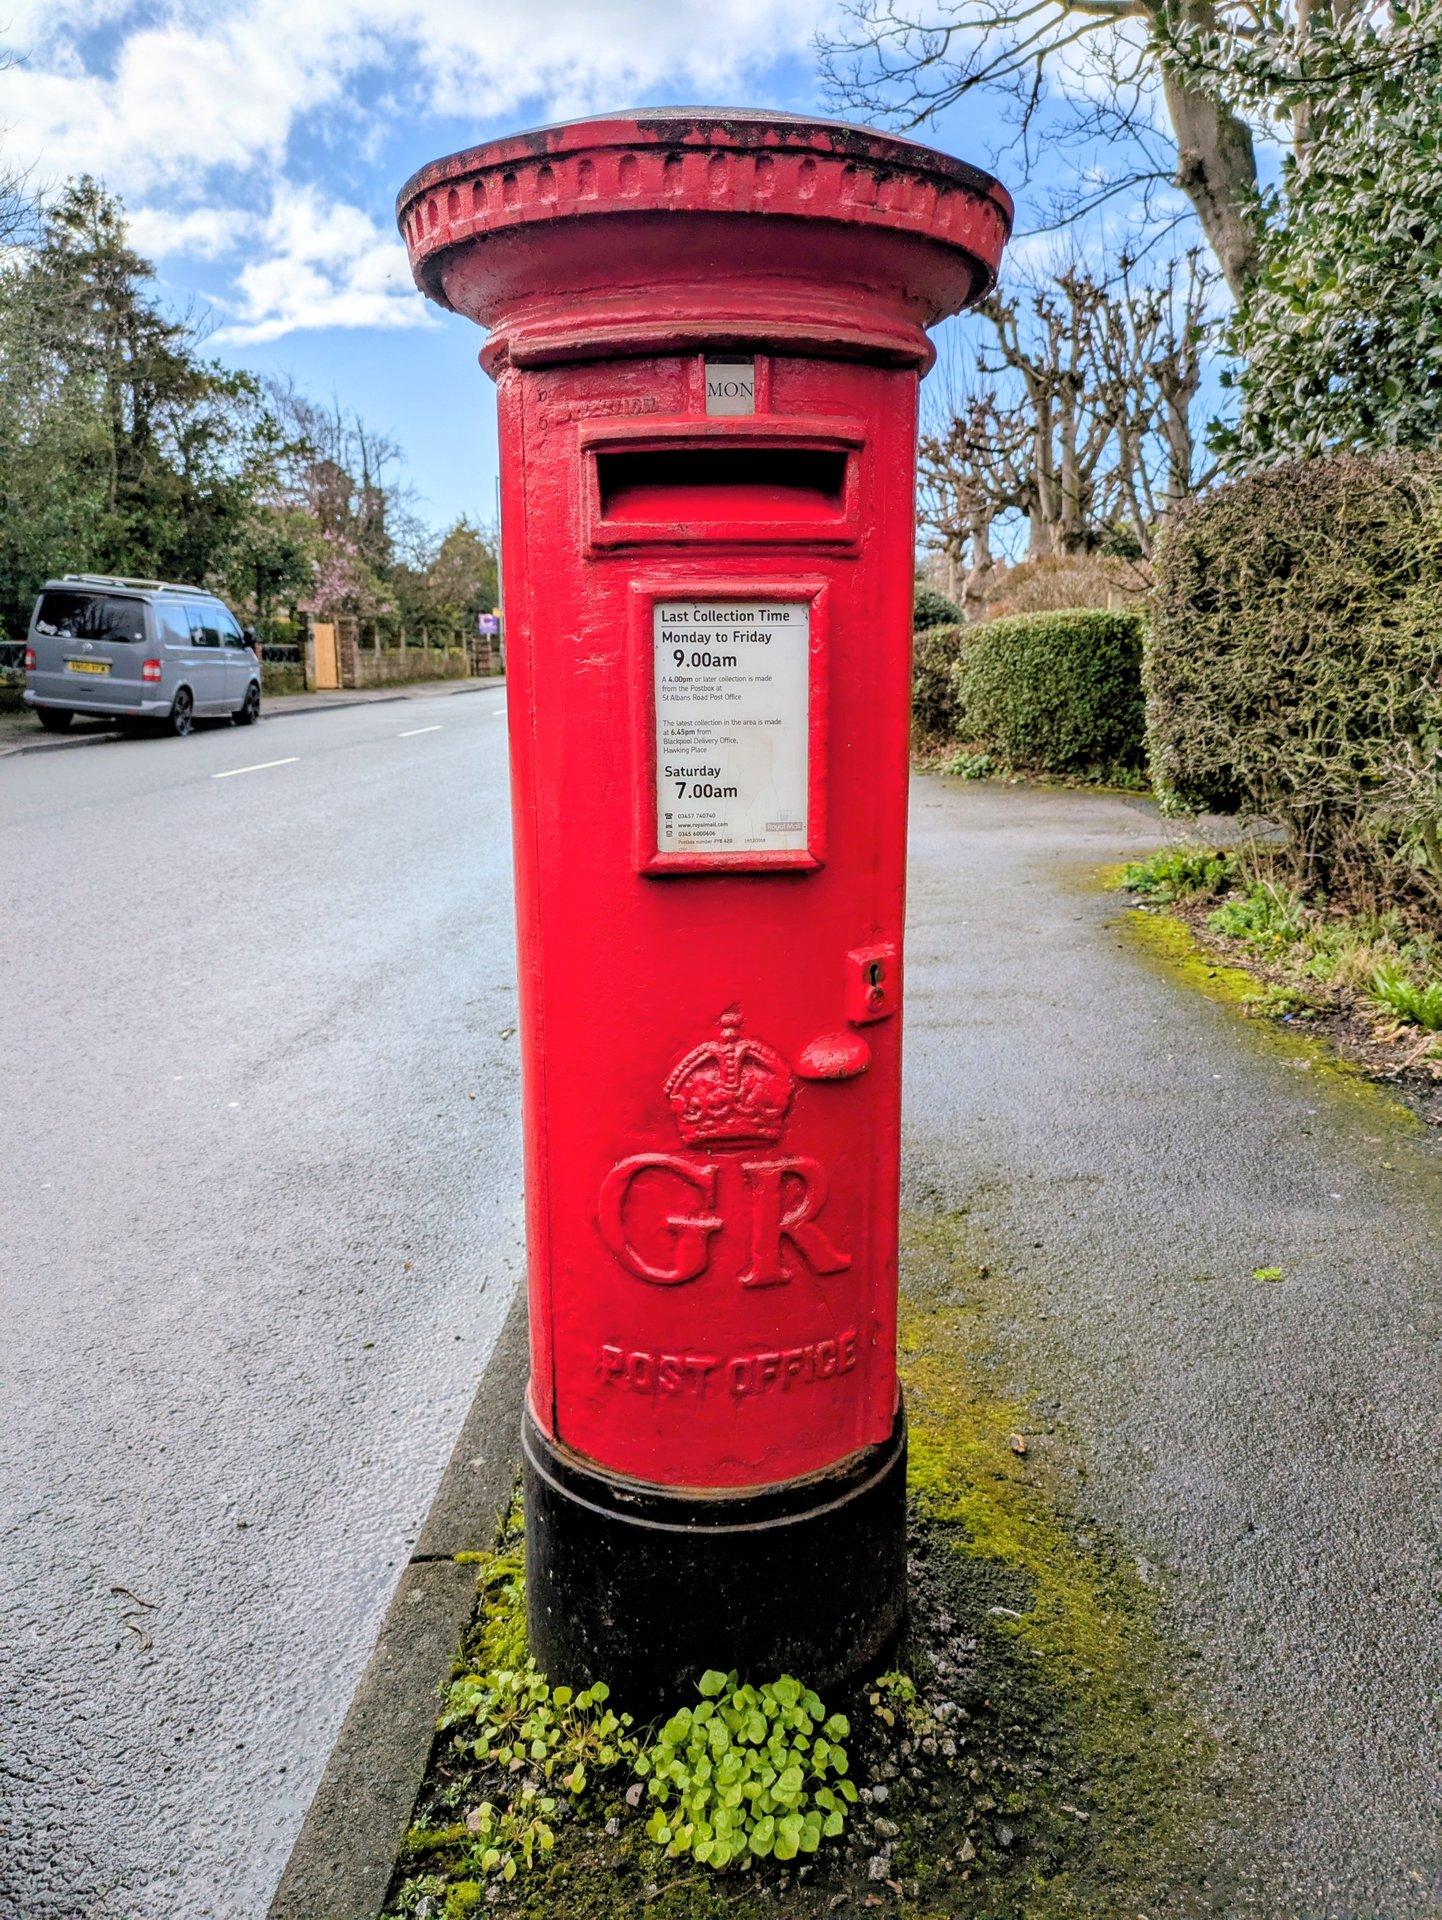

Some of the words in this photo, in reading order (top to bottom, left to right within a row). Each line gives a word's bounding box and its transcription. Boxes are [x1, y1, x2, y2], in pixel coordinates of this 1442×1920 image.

[708, 382, 754, 398] MON
[661, 610, 689, 622] Last
[693, 610, 754, 622] Collection
[759, 610, 790, 621] Time
[662, 632, 711, 645] Monday
[716, 632, 728, 642] to
[733, 631, 772, 644] Friday
[673, 649, 737, 668] 9.00am
[694, 737, 718, 745] Delivery
[665, 766, 721, 778] Saturday
[675, 782, 737, 799] 7.00am
[599, 1345, 719, 1397] POST
[725, 1329, 857, 1396] OFFICE
